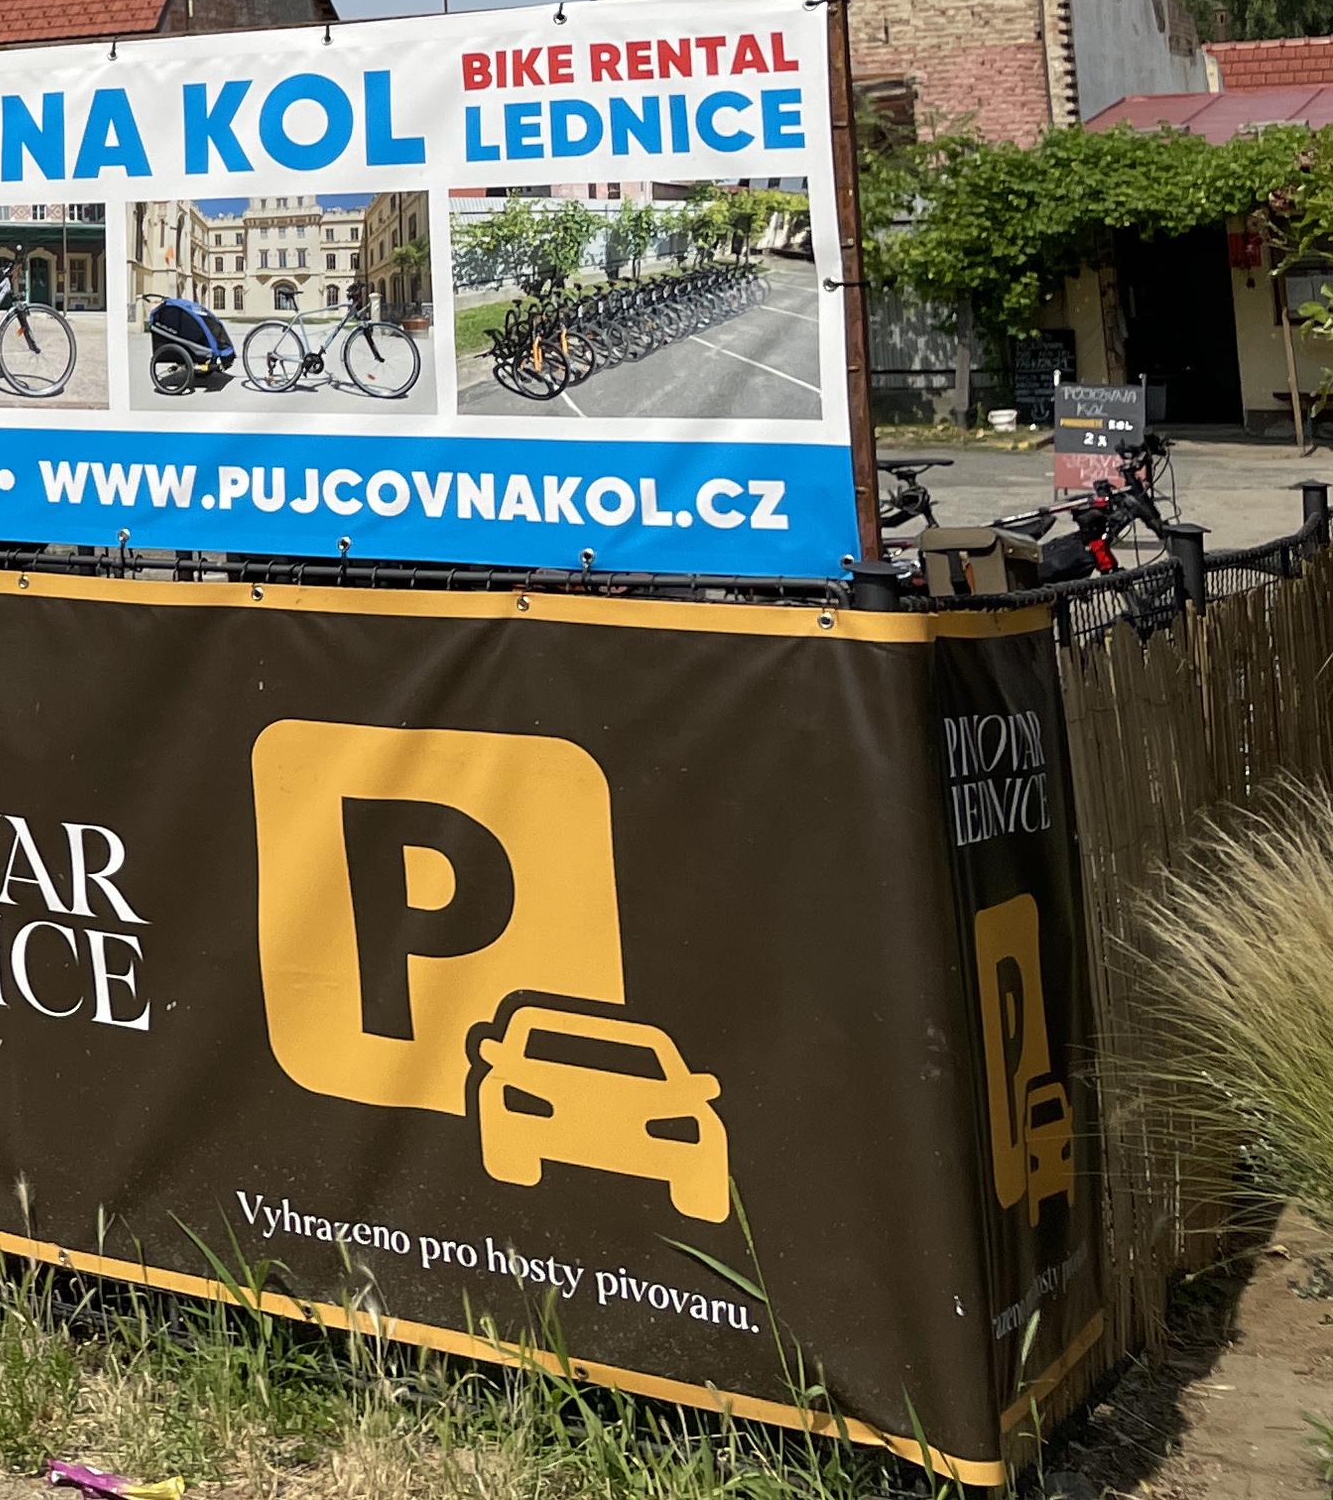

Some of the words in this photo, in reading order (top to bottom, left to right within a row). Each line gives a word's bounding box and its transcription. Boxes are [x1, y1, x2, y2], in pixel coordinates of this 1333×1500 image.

[461, 51, 574, 91] BIKE
[589, 32, 800, 83] RENTAL
[183, 70, 426, 176] KOL
[465, 88, 806, 163] LEDNICE
[1083, 432, 1094, 445] 2
[39, 461, 789, 531] WWW.PUJCOVNAKOL.CZ
[944, 711, 1045, 778] PIVOVAR
[341, 796, 515, 1042] P
[236, 1190, 411, 1255] Vyhrazeno
[418, 1234, 477, 1278] pro
[486, 1238, 584, 1298] hosty
[595, 1265, 761, 1334] pivovaru.
